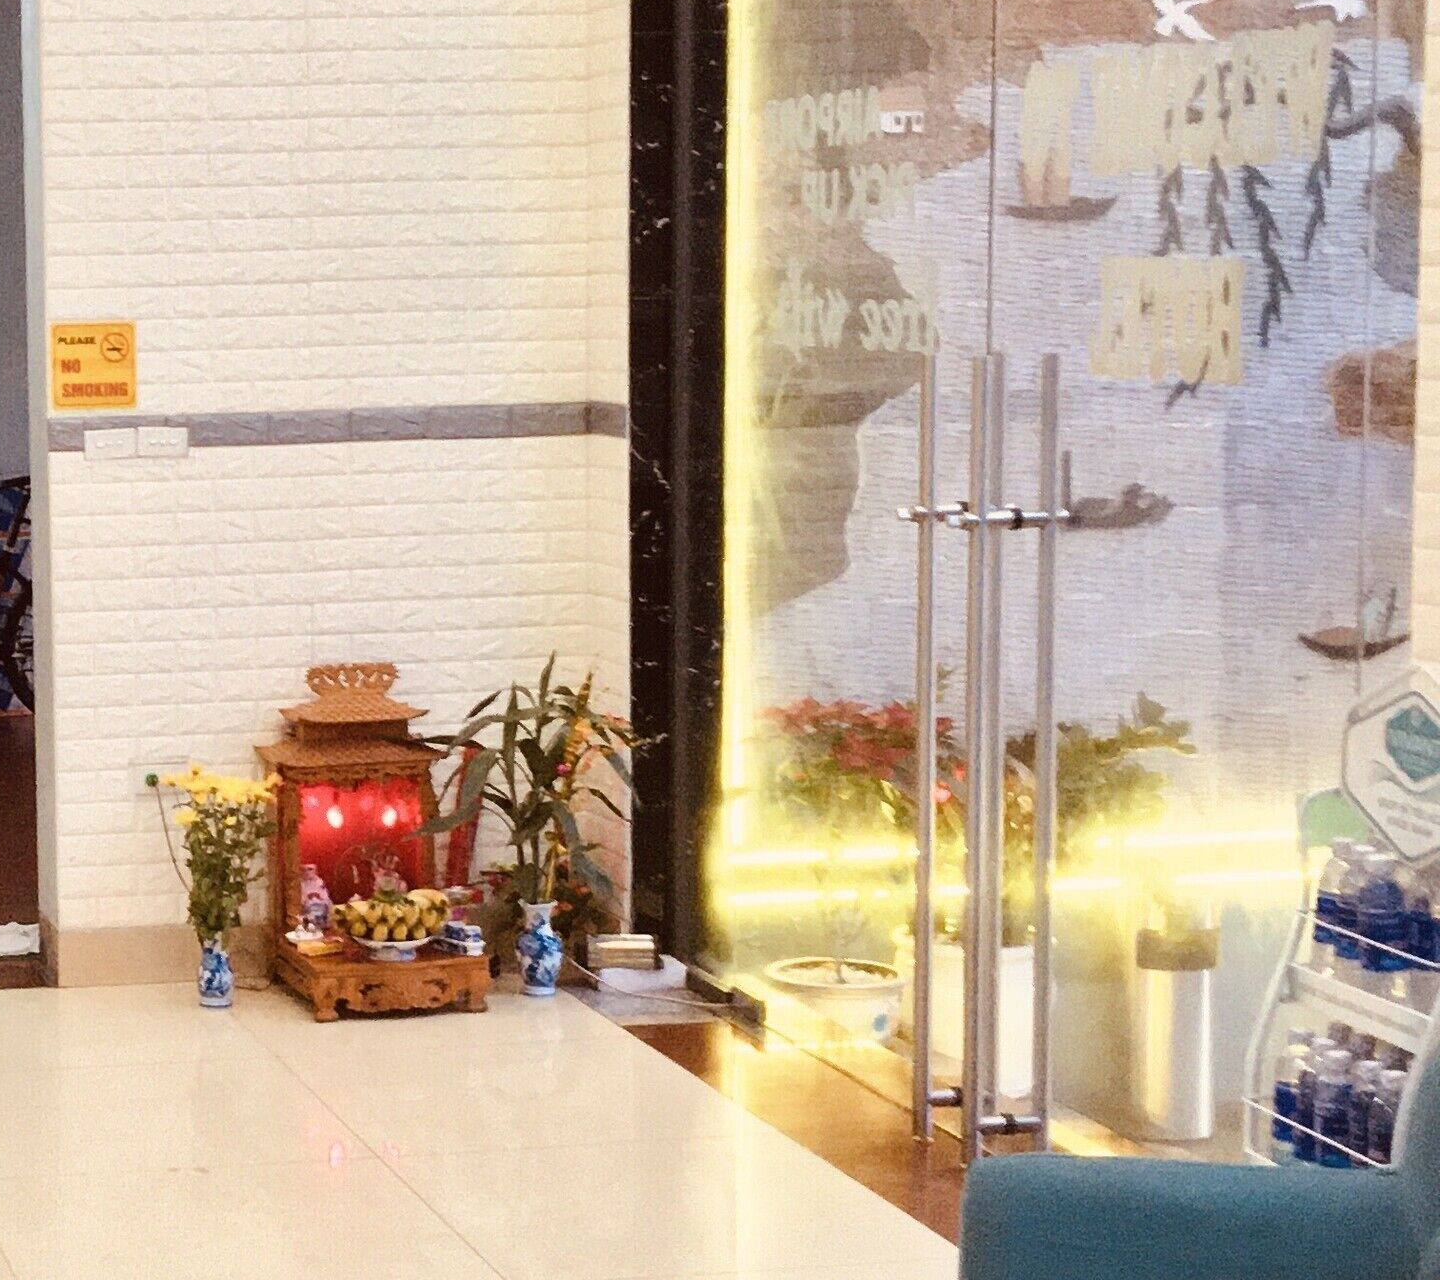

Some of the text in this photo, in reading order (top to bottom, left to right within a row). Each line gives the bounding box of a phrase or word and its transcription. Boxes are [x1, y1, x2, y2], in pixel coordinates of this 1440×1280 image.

[57, 336, 96, 345] PLEASE
[61, 359, 80, 373] NO
[62, 382, 128, 397] SMOKING
